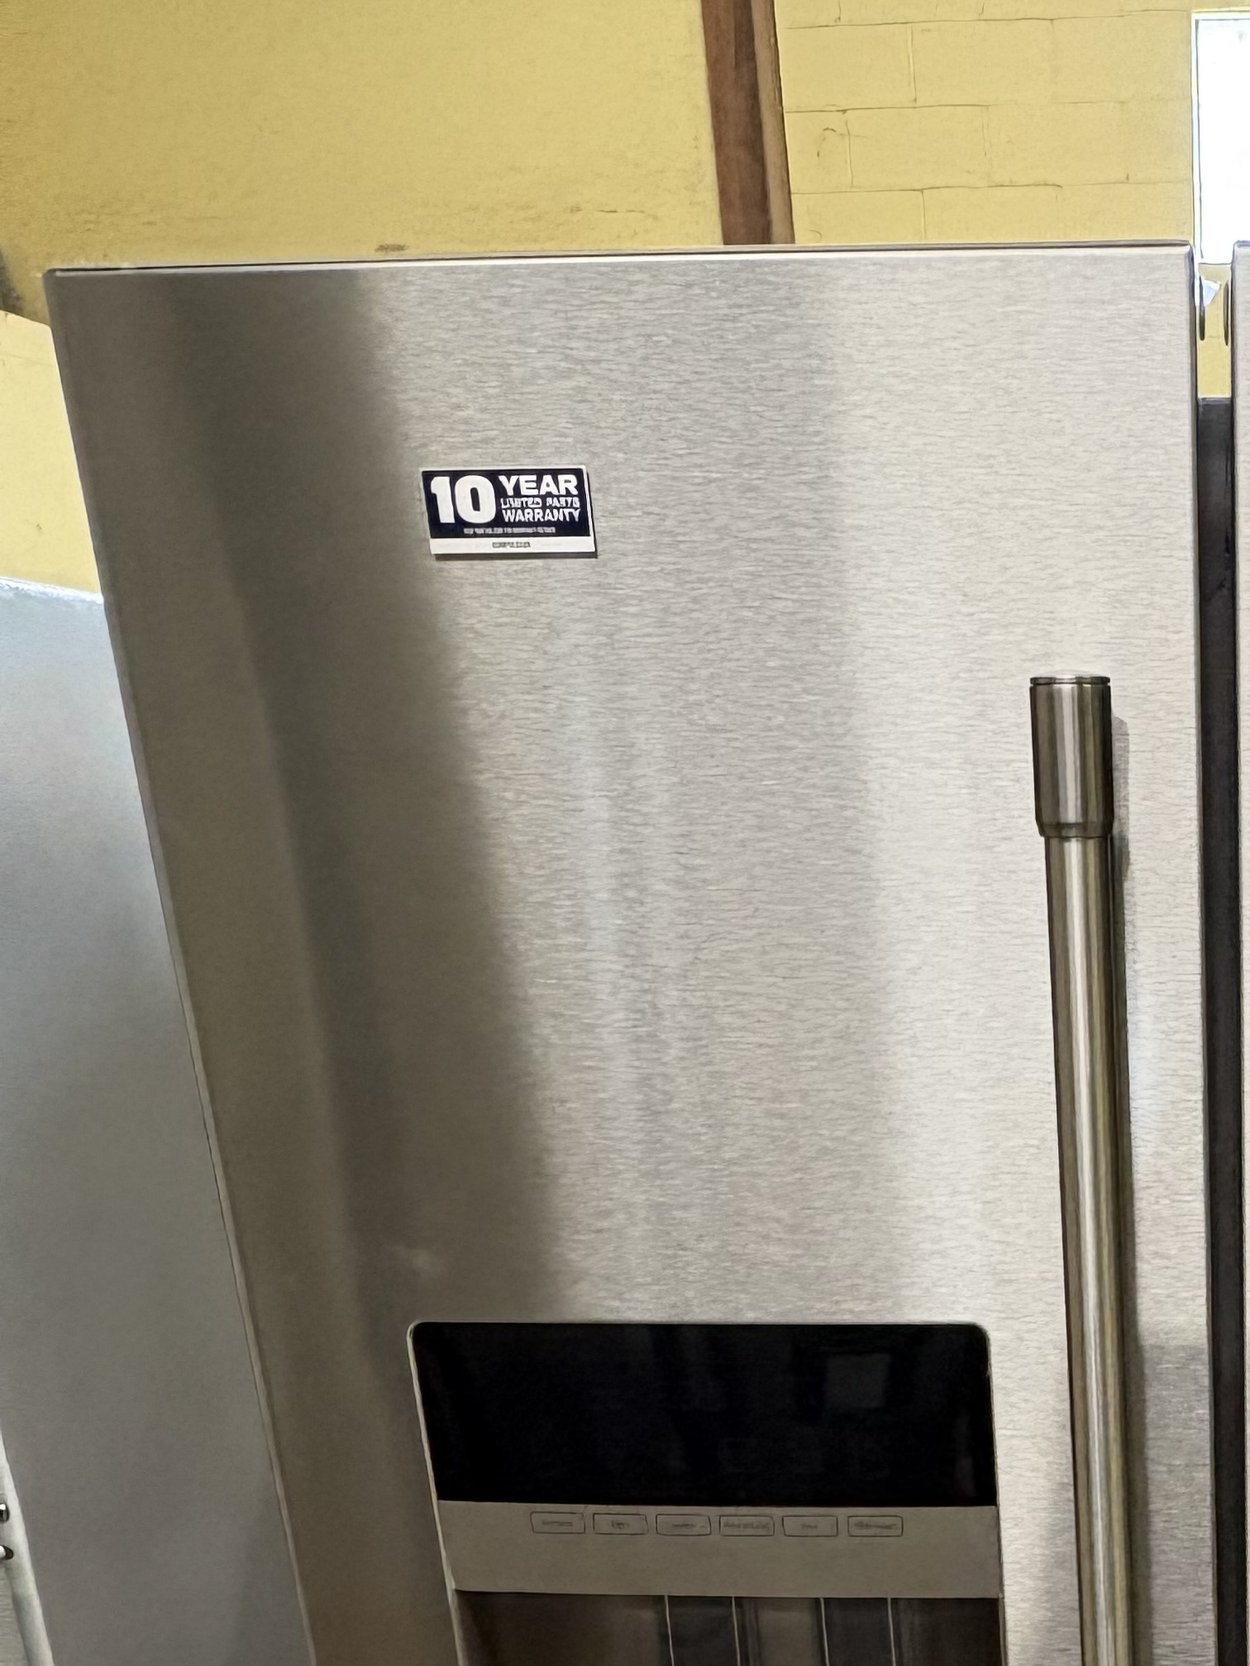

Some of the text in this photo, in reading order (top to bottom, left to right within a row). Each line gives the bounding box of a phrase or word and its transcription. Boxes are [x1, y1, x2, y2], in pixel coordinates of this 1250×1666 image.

[431, 474, 579, 524] 10 YEAR
[502, 508, 581, 522] WARRANTY
